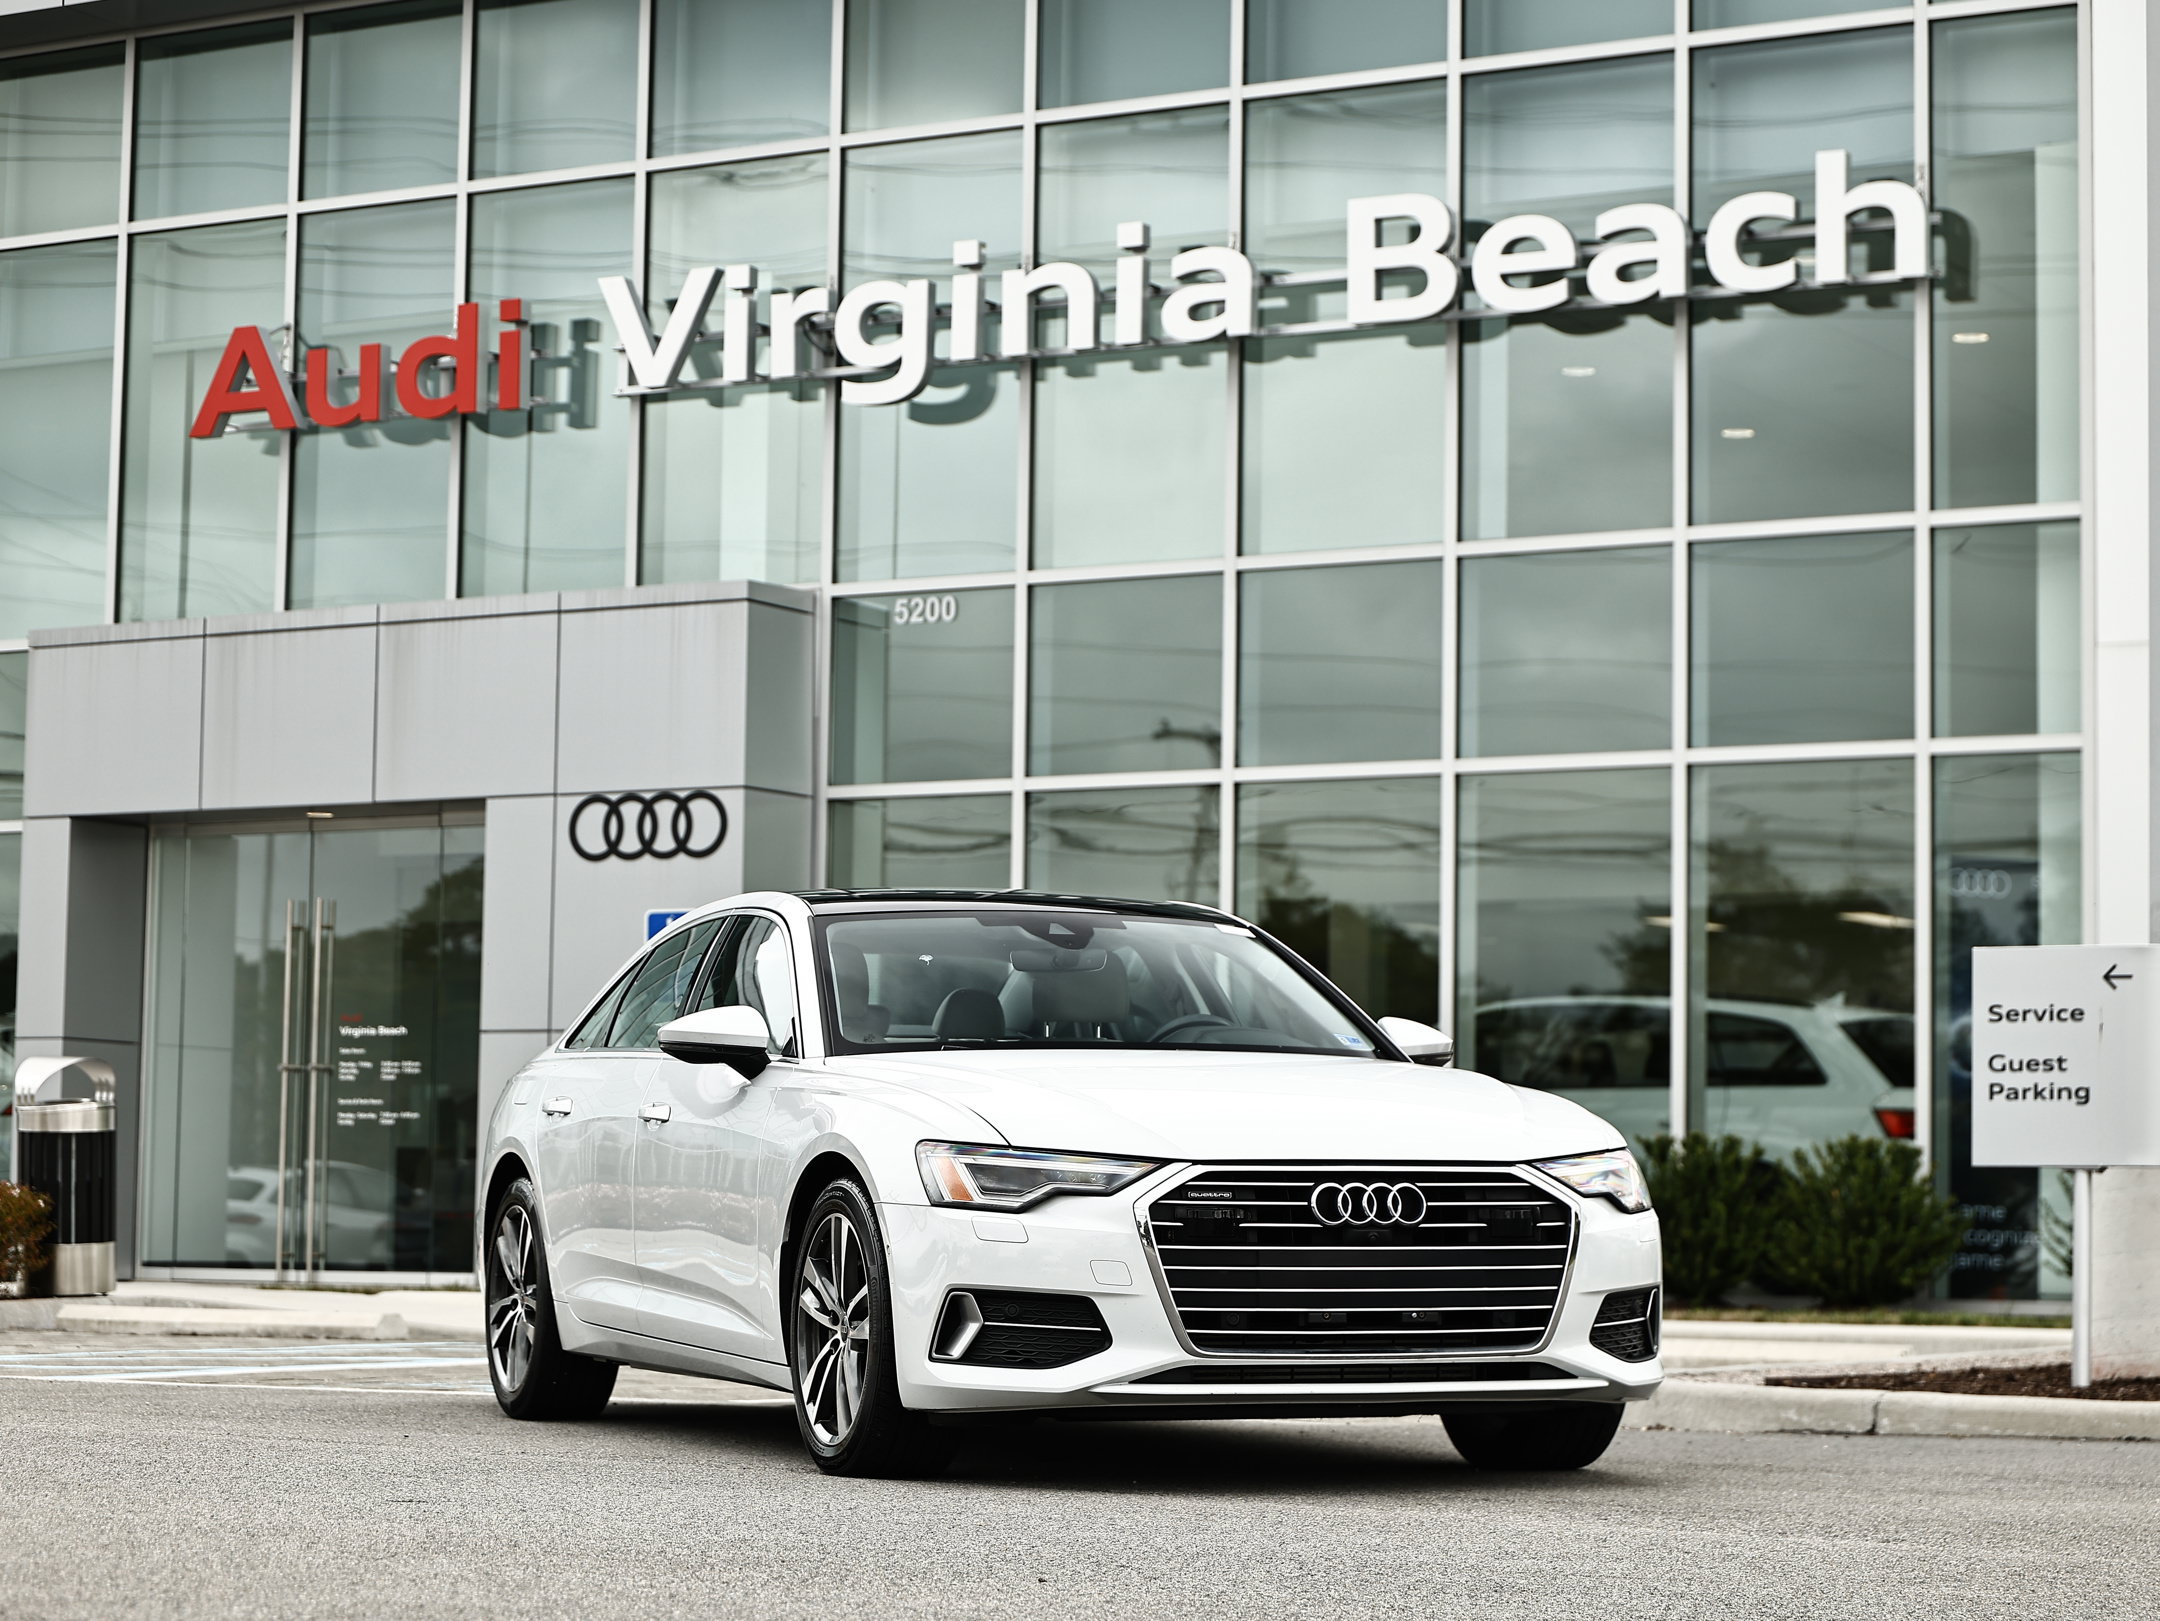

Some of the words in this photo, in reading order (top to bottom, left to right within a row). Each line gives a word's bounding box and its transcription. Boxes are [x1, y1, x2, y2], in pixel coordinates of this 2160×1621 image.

[189, 298, 531, 438] Audi
[599, 222, 1259, 406] Virginia
[1346, 150, 1931, 326] Beach
[894, 595, 957, 624] 5200
[1988, 1004, 2086, 1023] Service
[339, 1025, 377, 1038] Virginia
[1988, 1054, 2068, 1073] Guest
[1988, 1083, 2091, 1105] Parking
